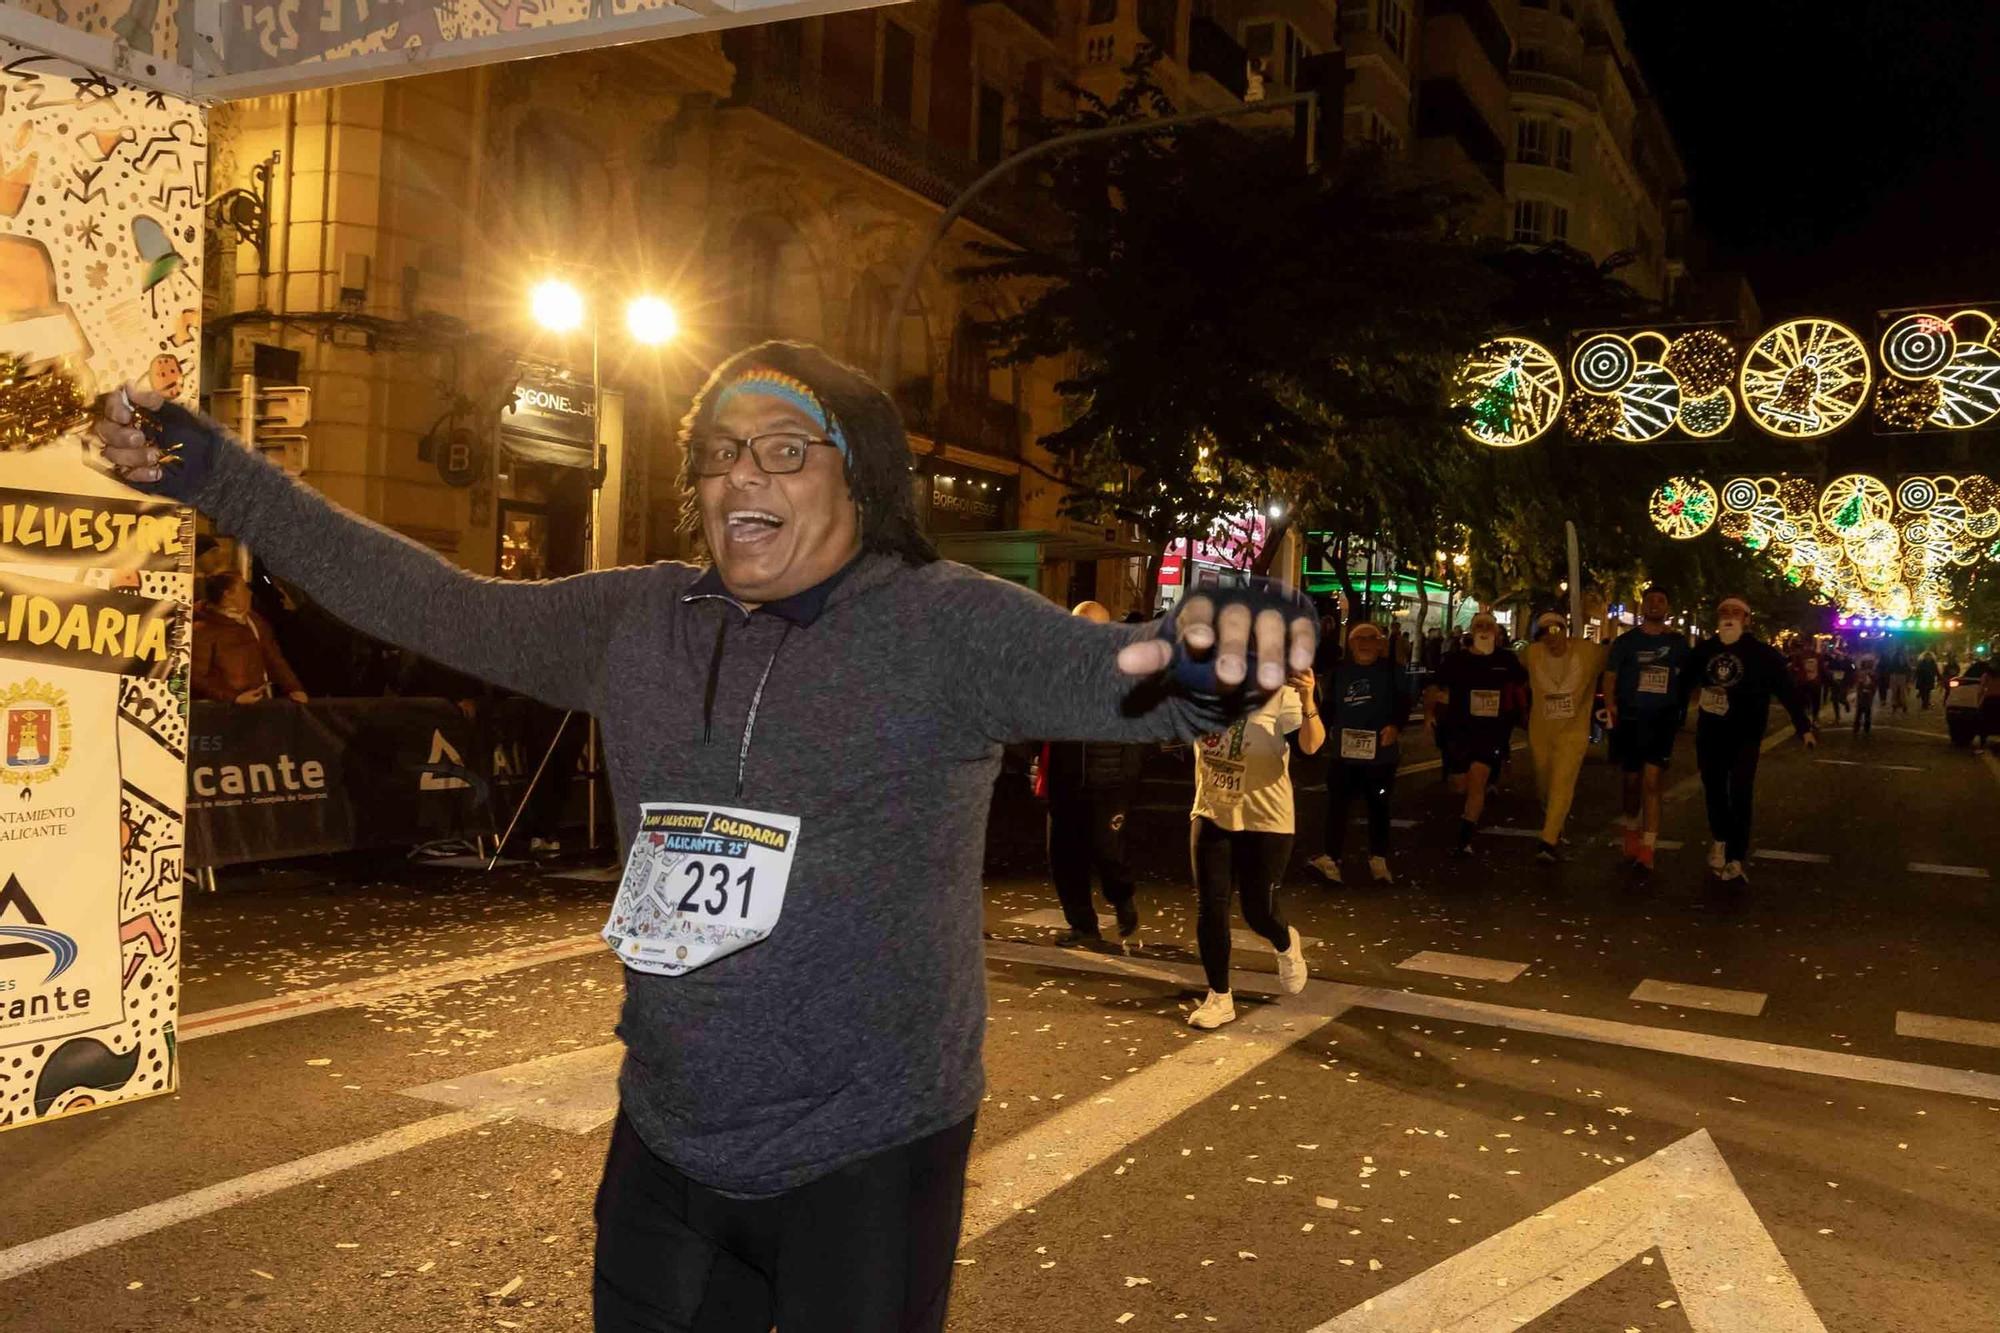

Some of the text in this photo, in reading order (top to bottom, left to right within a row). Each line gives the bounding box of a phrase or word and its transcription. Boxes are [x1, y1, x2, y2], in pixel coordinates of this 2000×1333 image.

[192, 753, 326, 797] cante
[1213, 771, 1241, 791] 2991
[1, 823, 67, 841] ALICANTE
[660, 814, 706, 829] SILVESTRE
[712, 817, 785, 848] SOLIDARIA
[666, 835, 723, 854] ALICANTE
[676, 860, 756, 919] 231
